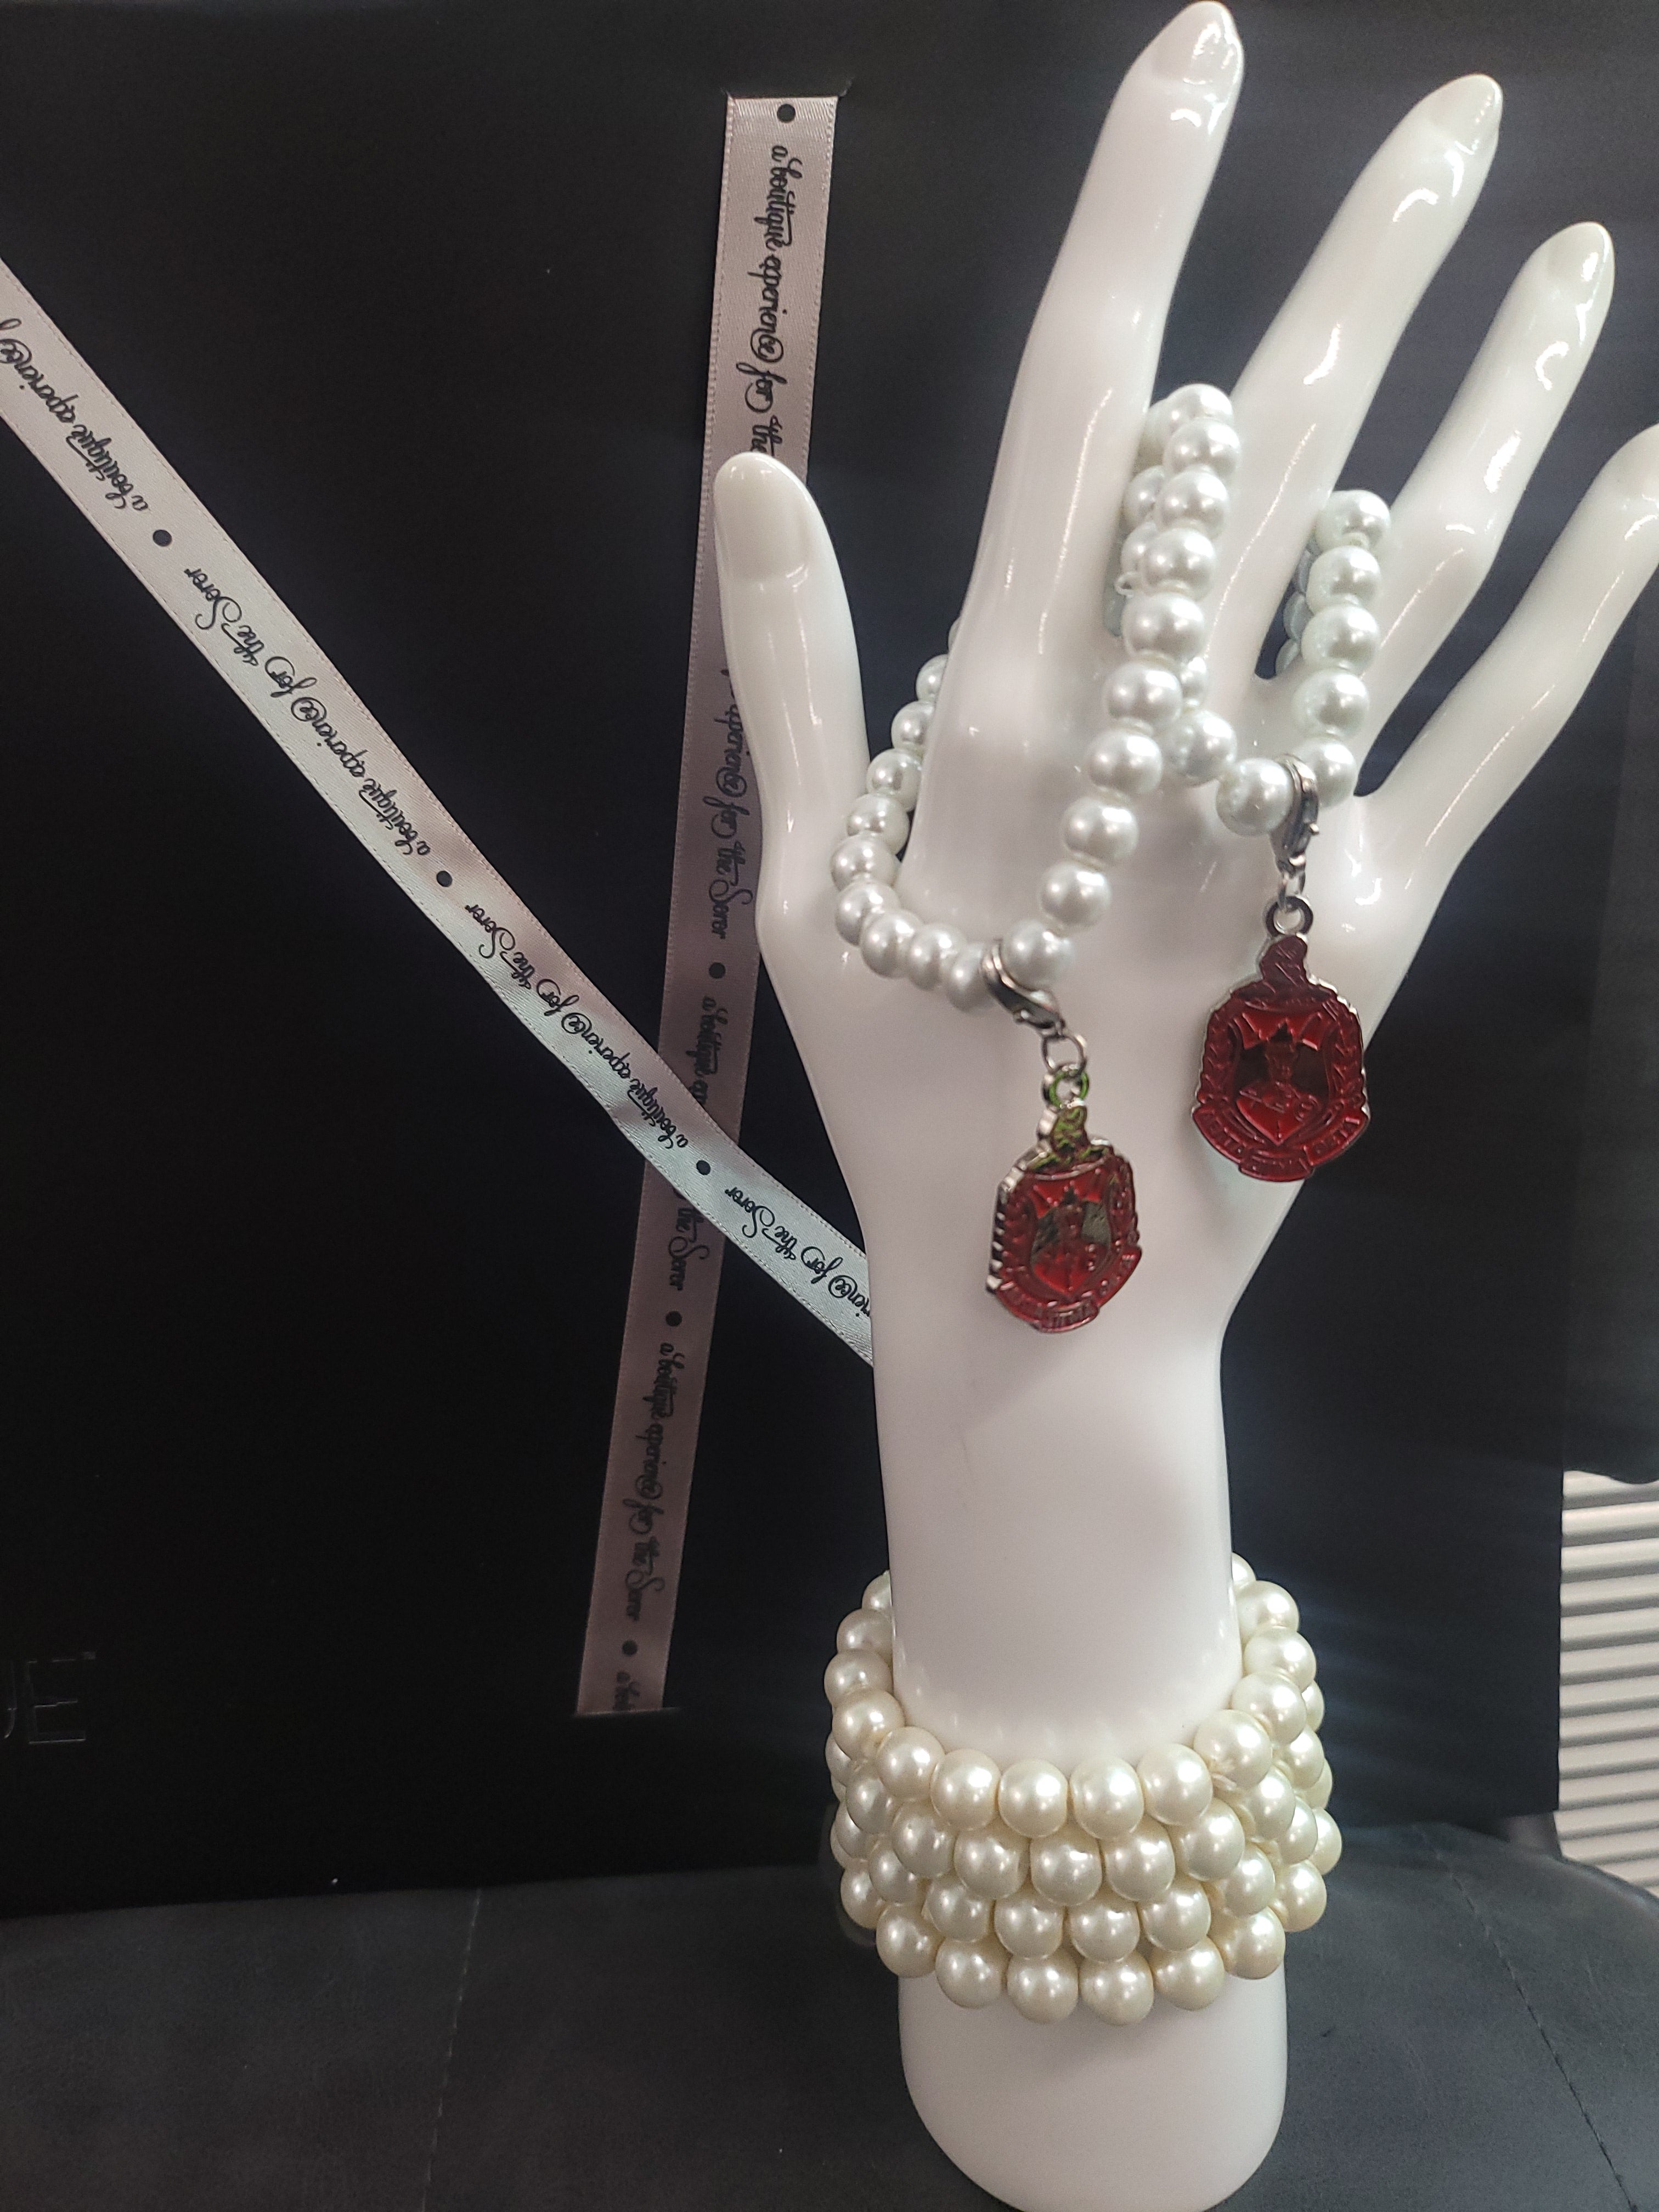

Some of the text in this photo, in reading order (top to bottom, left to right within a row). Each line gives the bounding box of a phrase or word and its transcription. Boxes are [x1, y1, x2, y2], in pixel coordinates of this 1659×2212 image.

[771, 145, 788, 162] a
[753, 158, 803, 251] boutique
[747, 254, 788, 363] experience
[736, 362, 787, 414] for
[65, 424, 134, 510] boutique
[131, 494, 149, 511] a
[221, 623, 264, 667] the
[264, 656, 318, 698] for
[291, 696, 368, 778] experience
[358, 778, 419, 855] boutique
[702, 795, 750, 839] for
[416, 840, 431, 856] a
[715, 840, 747, 887] the
[500, 951, 535, 990] the
[536, 978, 580, 1016] for
[561, 1012, 631, 1079] experience
[627, 1078, 676, 1149] boutique
[676, 1134, 689, 1148] a
[761, 1225, 798, 1260] the
[800, 1246, 844, 1284] for
[622, 1498, 664, 1535] for
